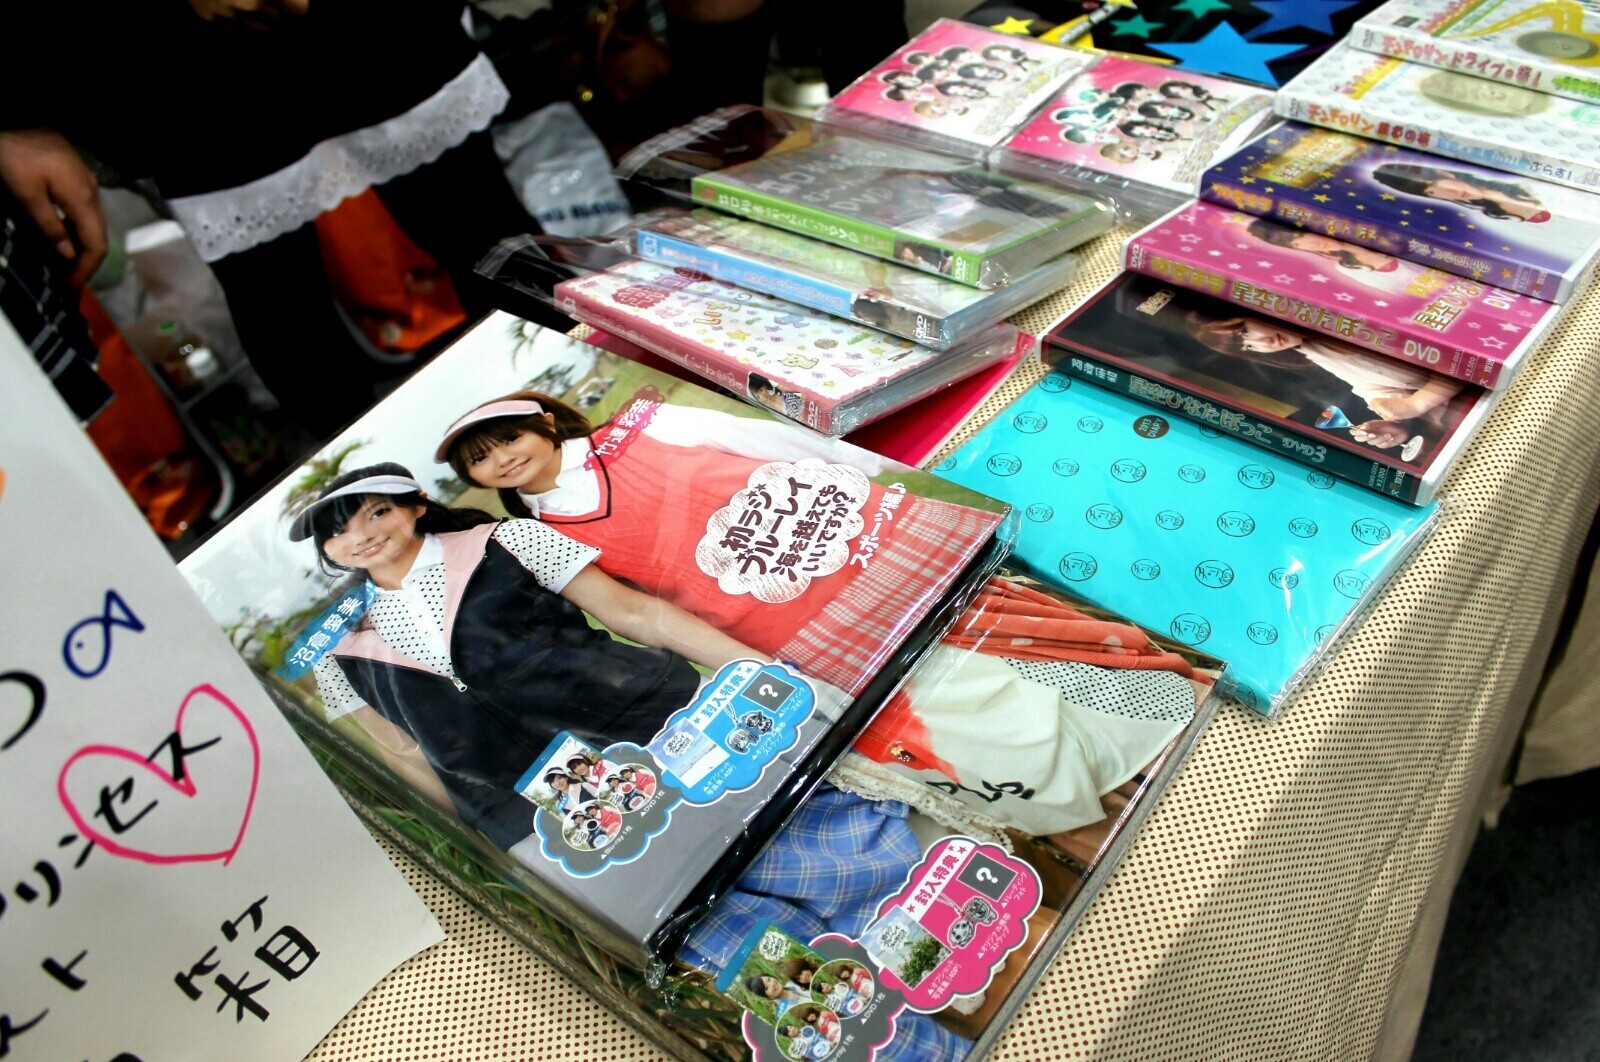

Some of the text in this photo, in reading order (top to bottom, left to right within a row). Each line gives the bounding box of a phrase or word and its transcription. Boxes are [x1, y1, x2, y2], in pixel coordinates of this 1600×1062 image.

[1232, 278, 1397, 349] 星空ひなたぼっこ
[1403, 340, 1440, 364] DVD
[595, 398, 655, 457] 竹達彩奈
[1129, 374, 1273, 444] 星空ひなたぼっこ
[1139, 418, 1152, 432] 2013
[1148, 418, 1164, 438] DIARY
[718, 484, 773, 551] 初ラジ
[735, 476, 813, 575] ブルーレイ
[770, 483, 838, 582] 海を越えても
[289, 596, 361, 667] 沼倉愛美
[701, 674, 746, 719] 封入特典
[0, 730, 222, 916] リンセス
[914, 853, 960, 906] 封入特典
